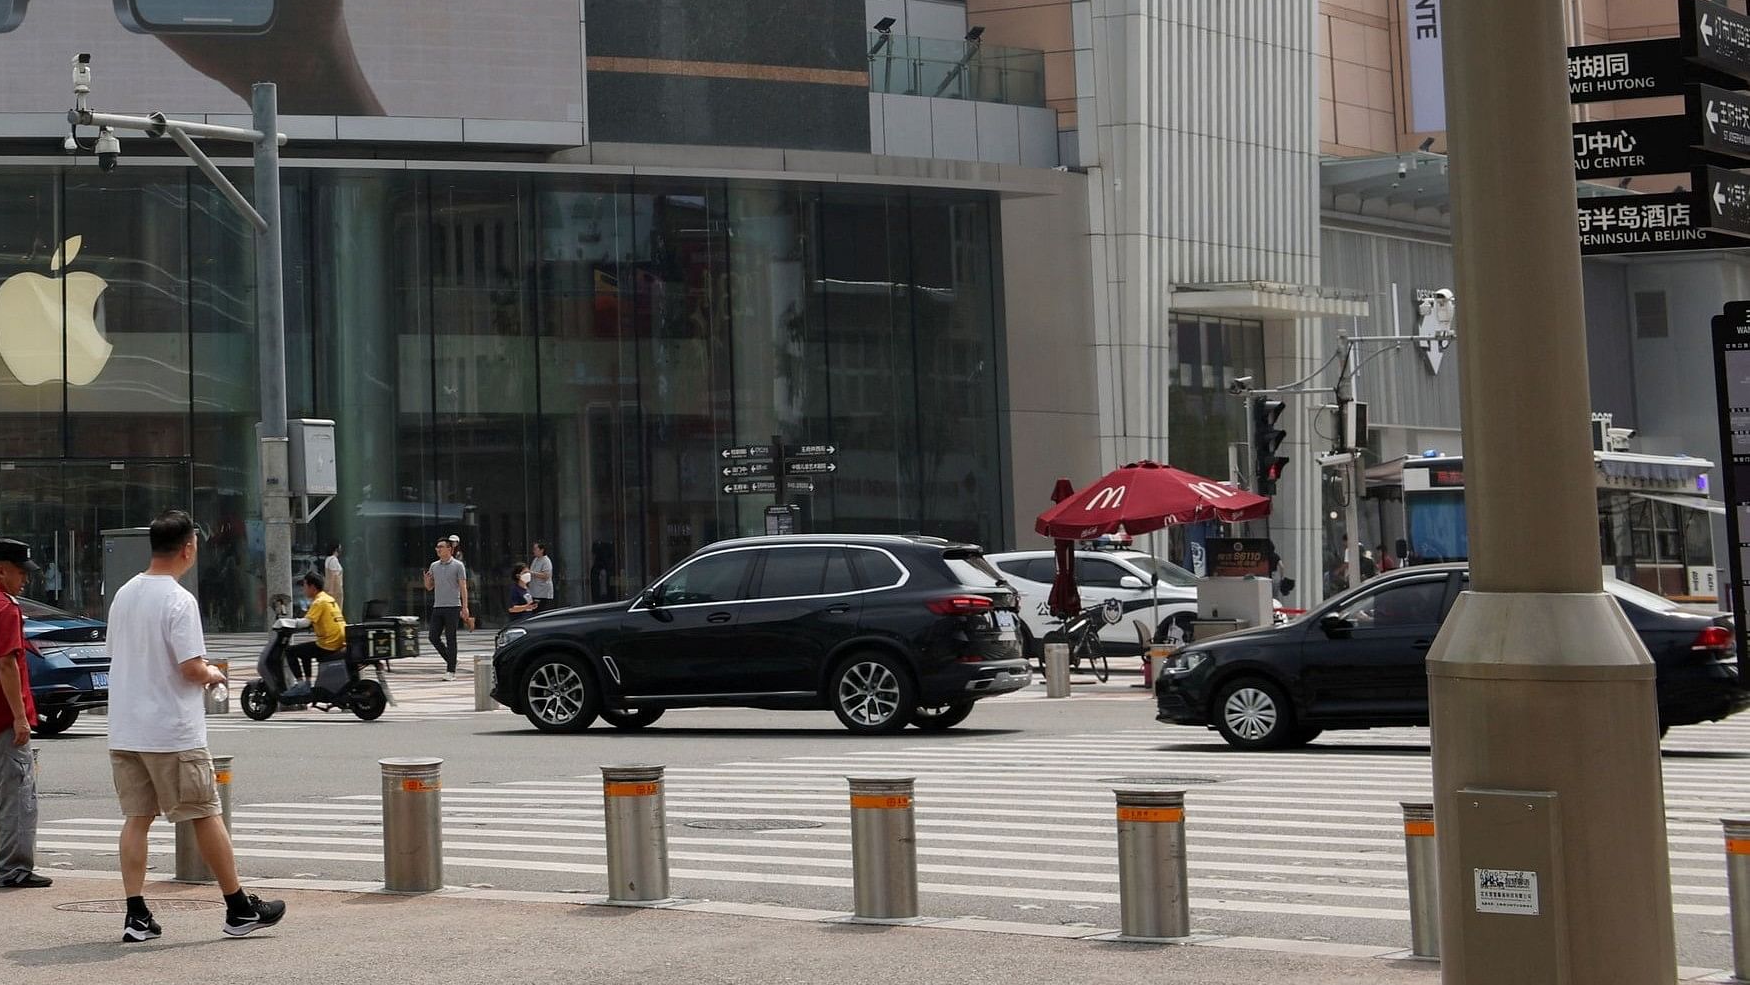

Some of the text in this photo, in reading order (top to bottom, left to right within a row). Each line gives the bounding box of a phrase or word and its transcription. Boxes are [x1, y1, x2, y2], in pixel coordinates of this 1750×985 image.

[1597, 77, 1656, 92] HUTONG
[1594, 155, 1646, 169] CENTER
[1655, 228, 1707, 242] BEIJING
